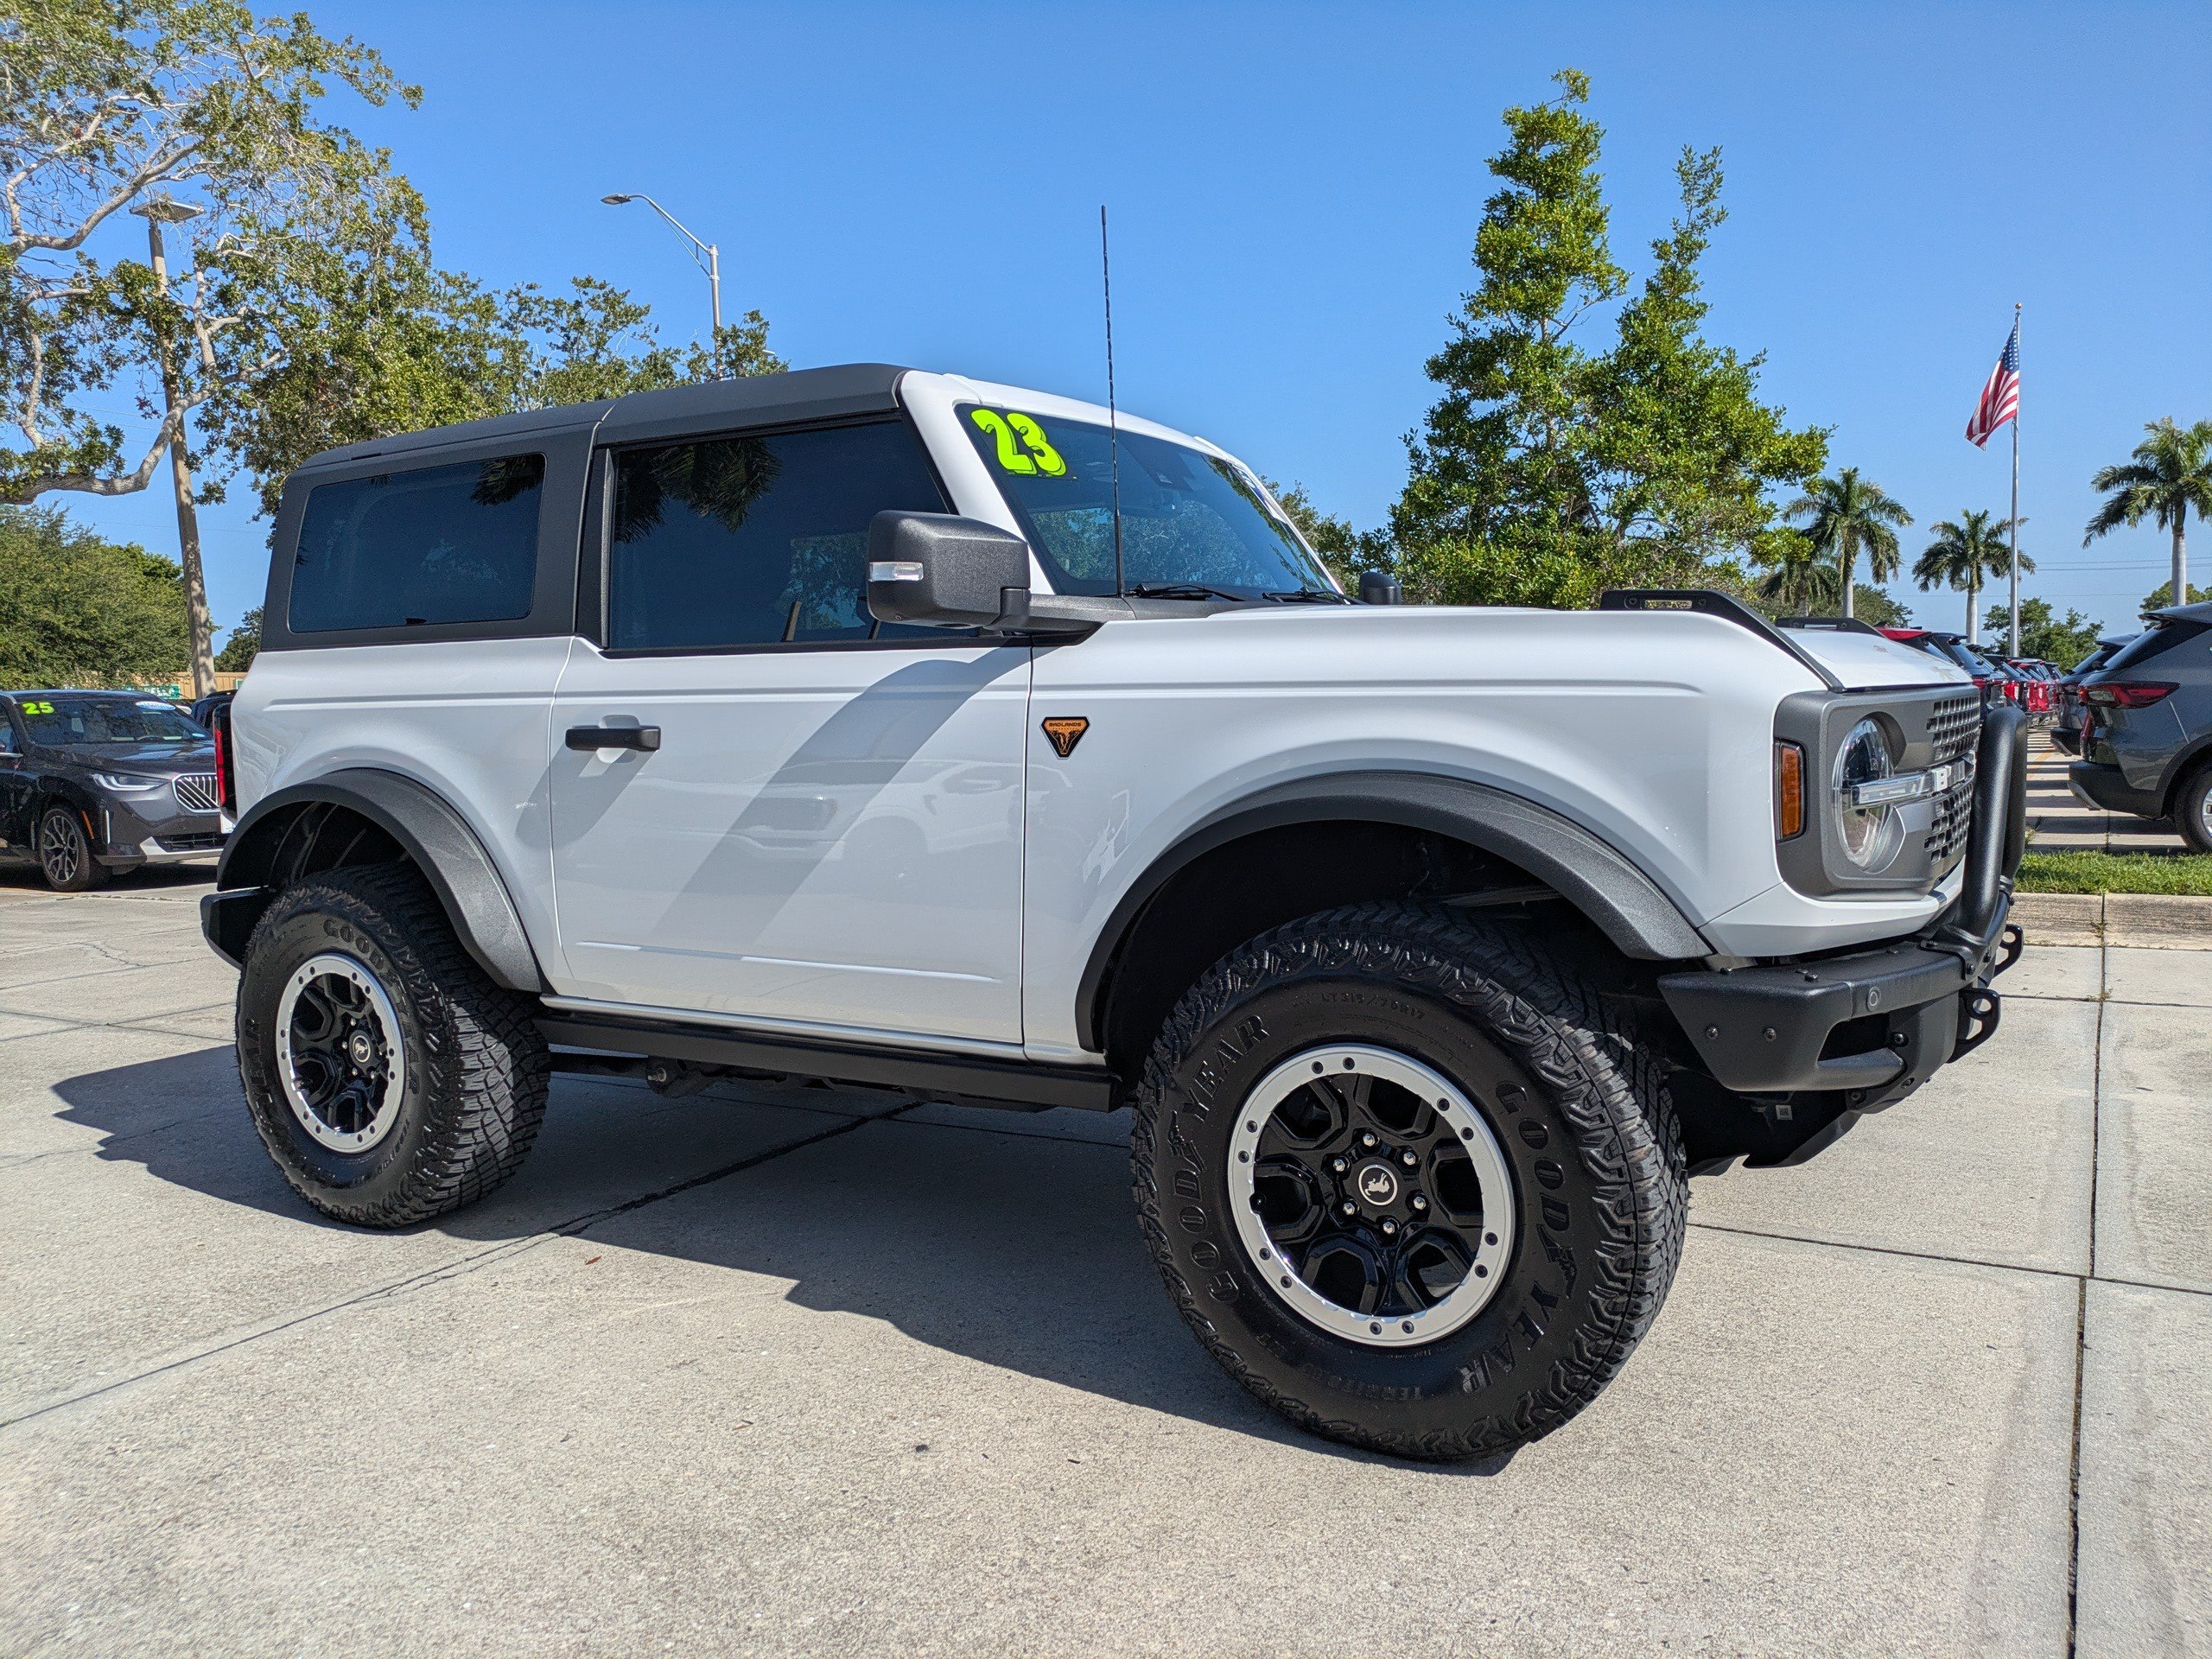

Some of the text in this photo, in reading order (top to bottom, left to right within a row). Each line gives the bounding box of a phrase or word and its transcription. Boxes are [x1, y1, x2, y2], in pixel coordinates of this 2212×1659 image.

[970, 409, 1066, 476] 23
[22, 702, 54, 715] 25
[1169, 1013, 1270, 1303] GOODYEAR
[1460, 1080, 1579, 1393] GOODYEAR
